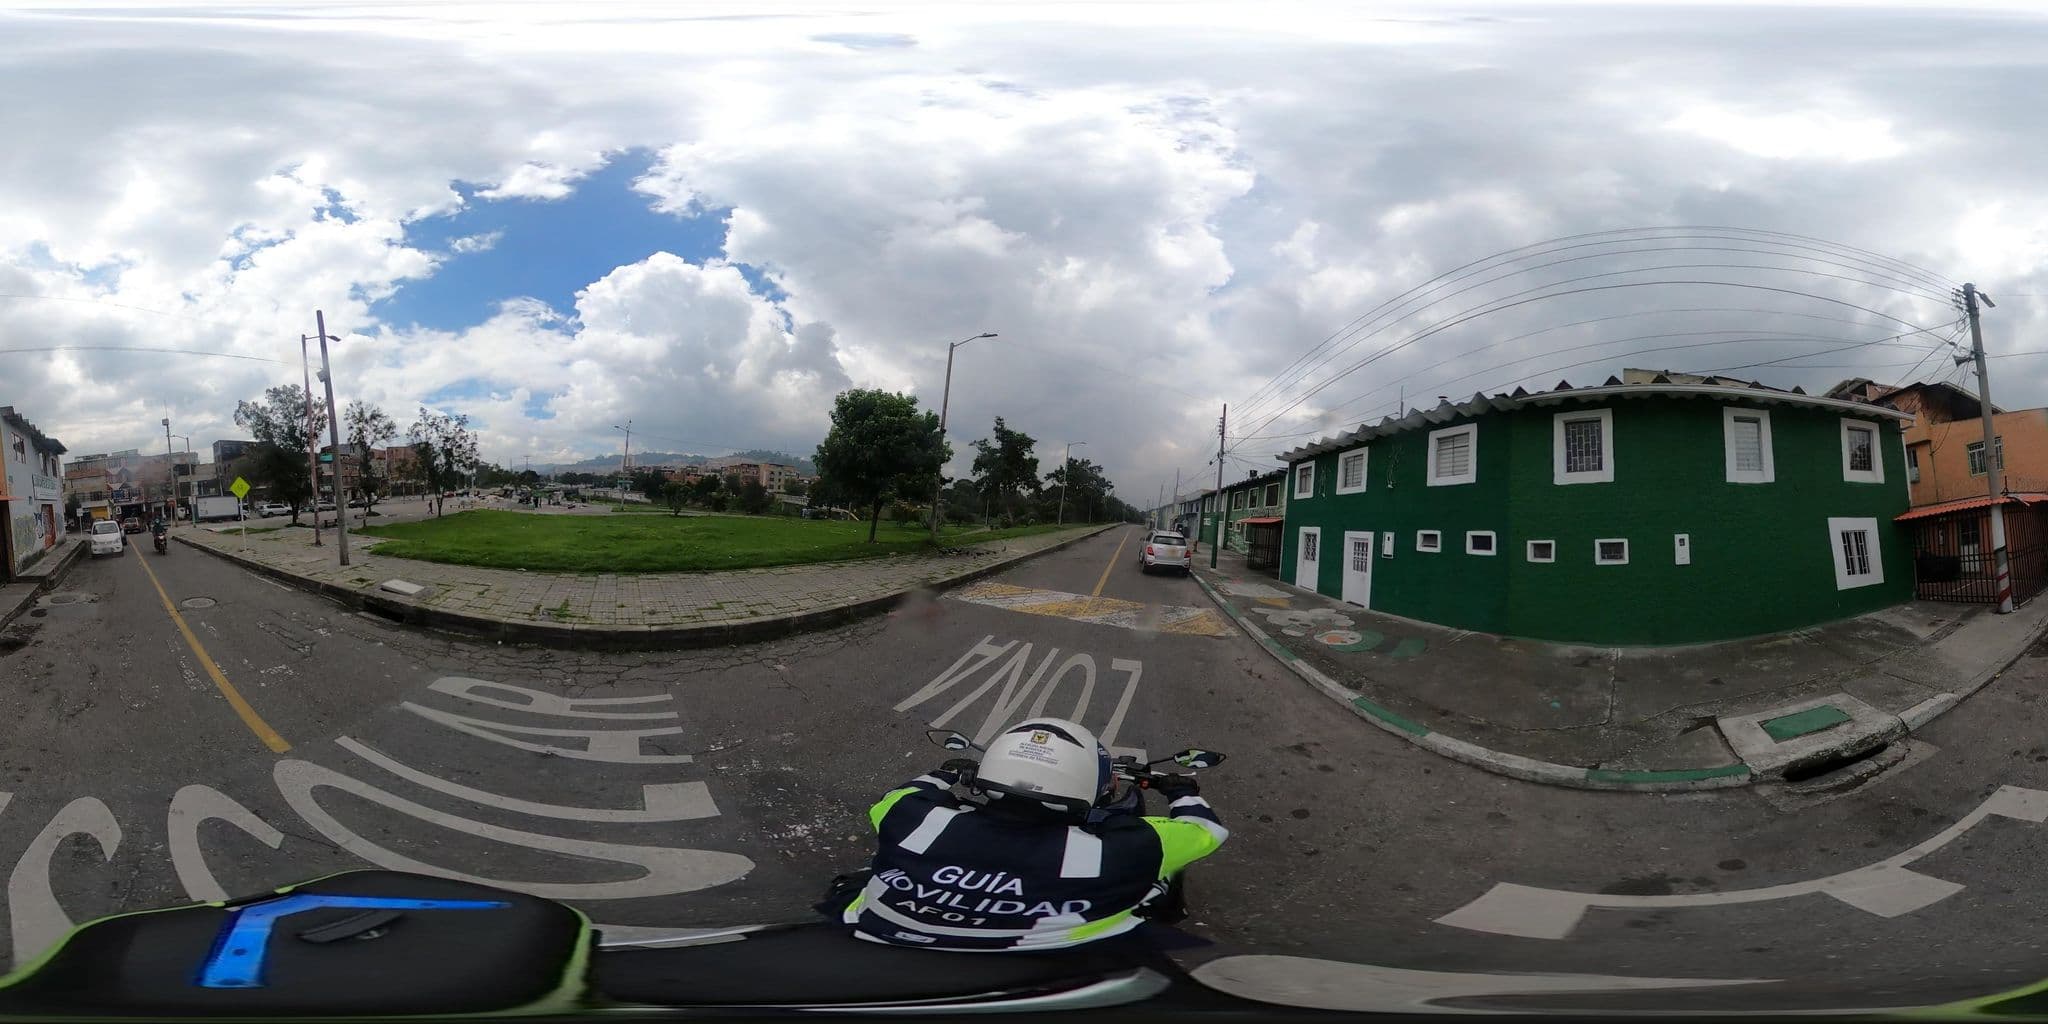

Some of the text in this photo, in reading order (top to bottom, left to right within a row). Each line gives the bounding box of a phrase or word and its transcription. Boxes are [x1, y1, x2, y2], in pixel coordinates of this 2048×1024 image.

[893, 635, 1148, 764] ZONA
[879, 868, 1093, 917] MOVILIDAD
[931, 865, 1024, 896] GUÍA
